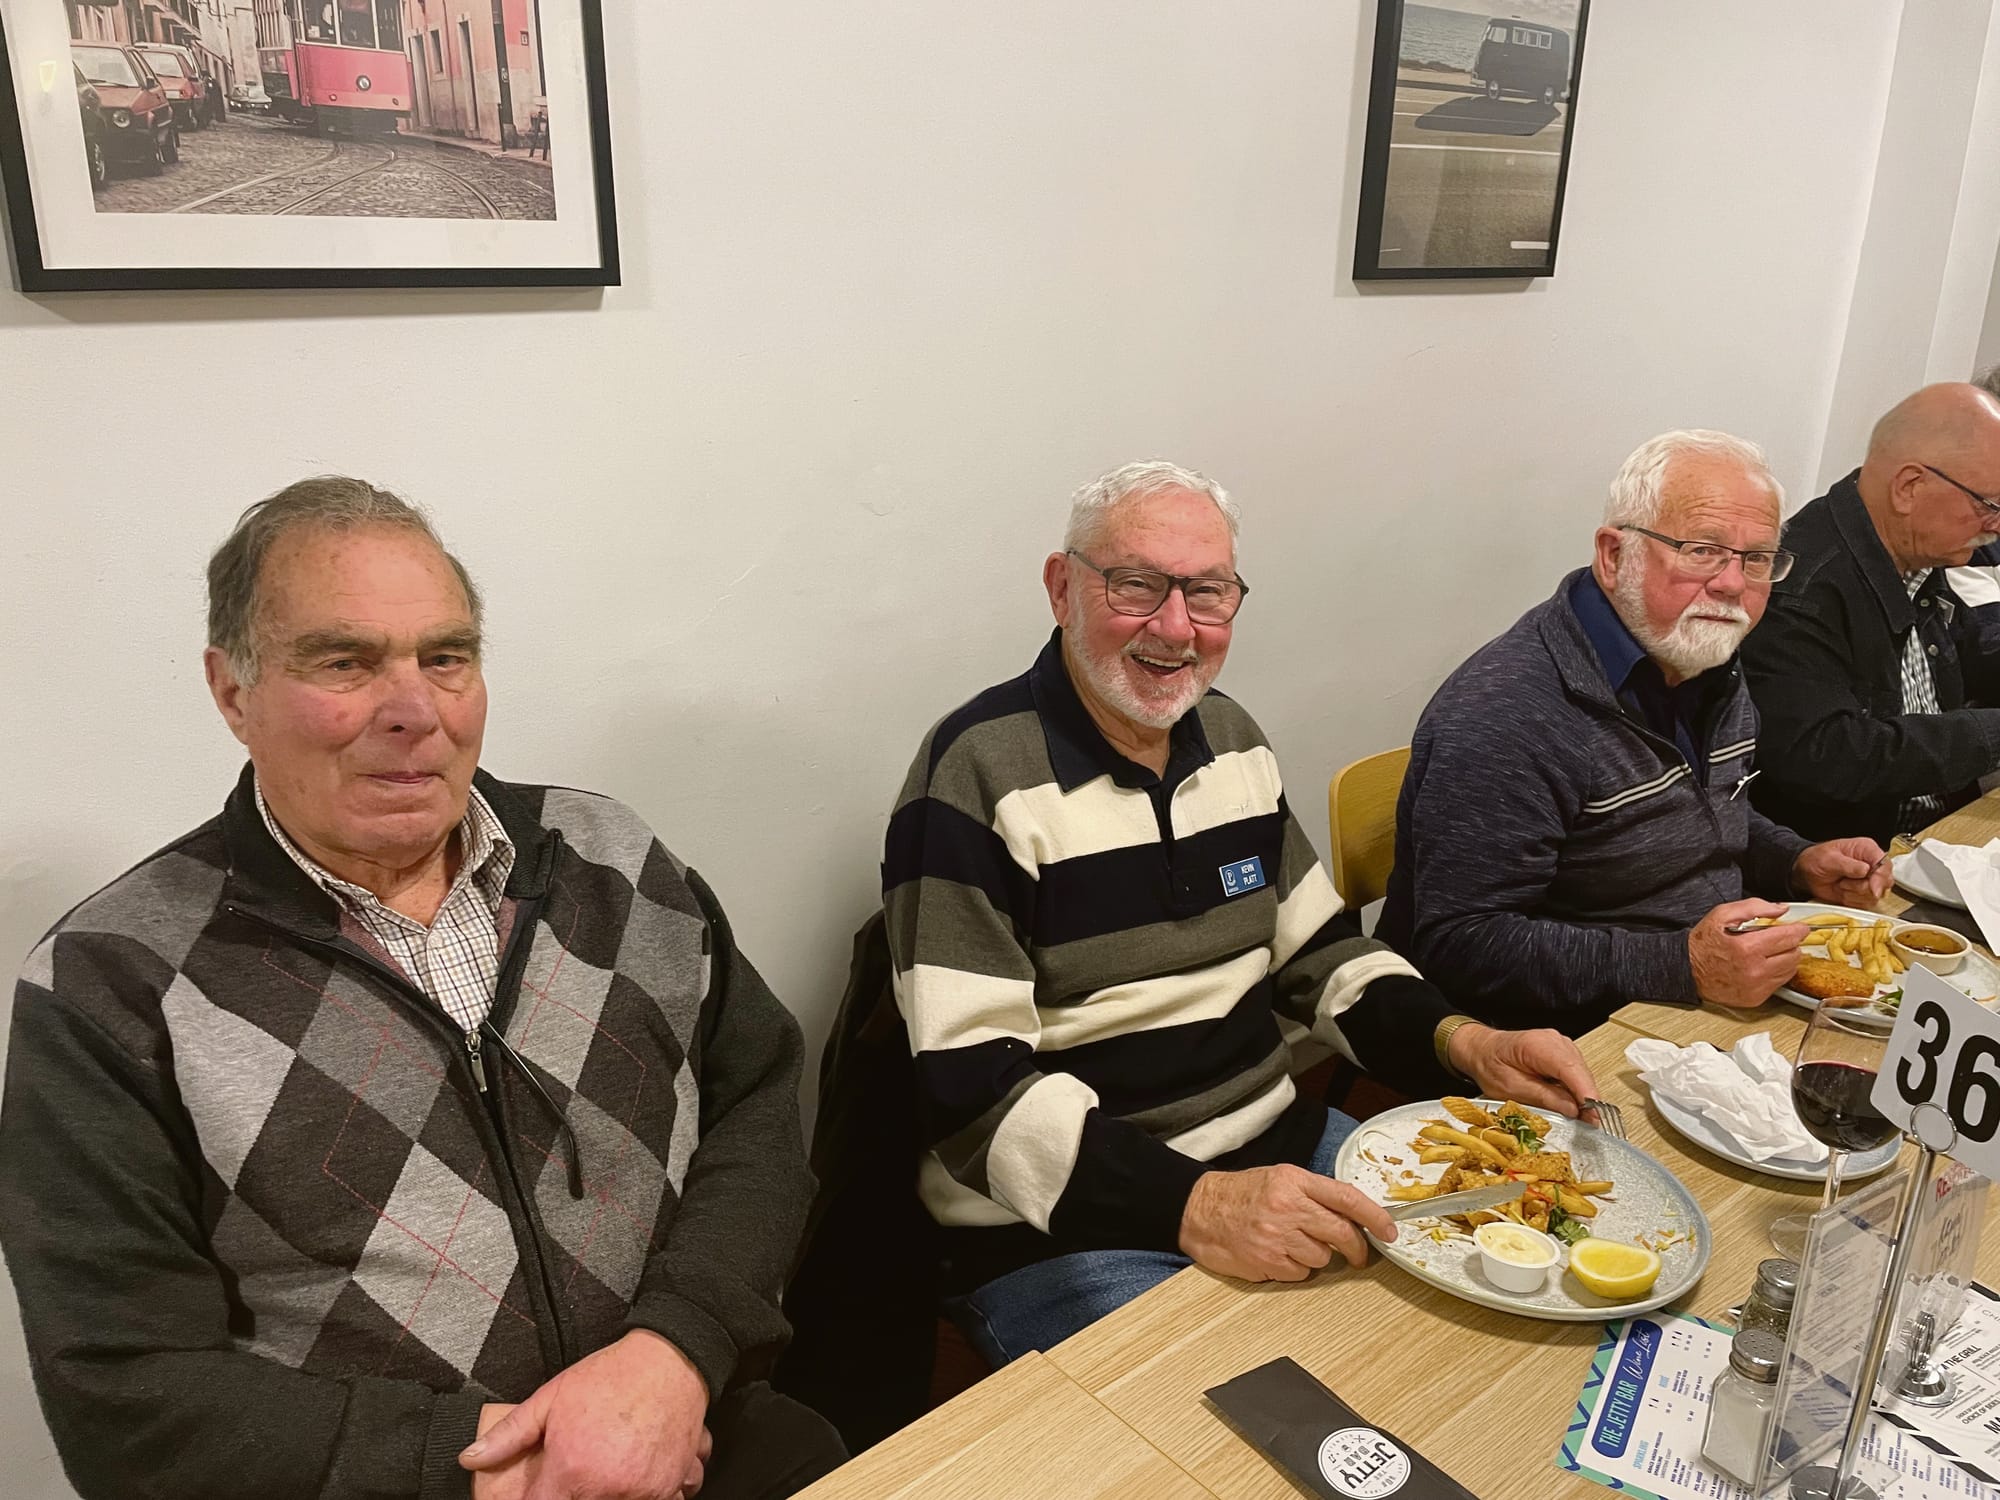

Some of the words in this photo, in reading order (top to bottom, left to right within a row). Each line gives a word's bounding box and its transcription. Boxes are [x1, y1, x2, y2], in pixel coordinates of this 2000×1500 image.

[1896, 1000, 2000, 1143] 36
[1632, 1328, 1652, 1359] List
[1622, 1350, 1643, 1380] Wine
[1615, 1380, 1638, 1400] BAR
[1606, 1398, 1632, 1429] JETTY
[1598, 1426, 1623, 1447] THE
[1339, 1442, 1396, 1489] JETTY
